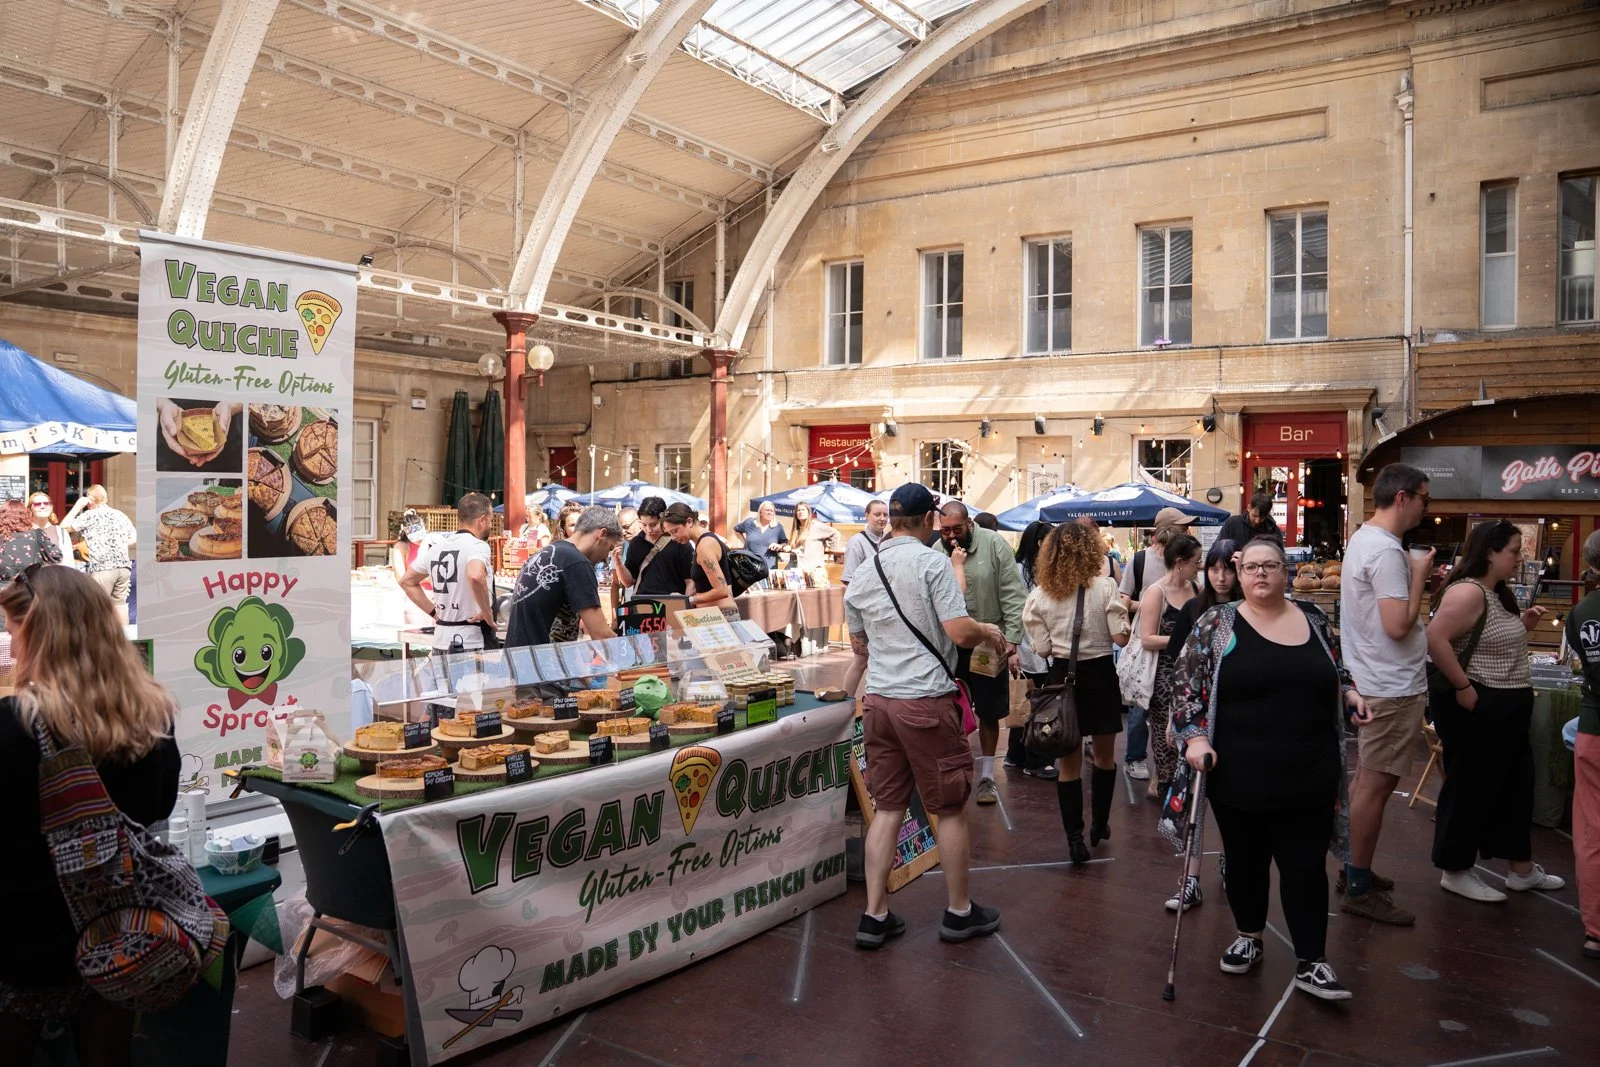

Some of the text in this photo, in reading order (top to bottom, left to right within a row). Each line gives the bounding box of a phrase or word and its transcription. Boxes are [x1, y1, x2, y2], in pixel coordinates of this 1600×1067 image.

[164, 259, 288, 312] VEGAN
[167, 309, 299, 359] QUICHE
[164, 359, 335, 397] Gluten-Free Options
[1280, 426, 1314, 441] Bar
[1501, 455, 1564, 494] Bath
[202, 570, 299, 599] Happy
[619, 620, 626, 636] 1
[627, 625, 640, 636] slice
[640, 617, 667, 635] £5.50
[213, 746, 263, 769] MADE
[715, 739, 852, 819] QUICHE
[456, 790, 665, 895] VEGAN
[579, 824, 784, 924] Gluten-Free Options
[539, 938, 619, 994] MADE
[628, 922, 659, 961] BY
[667, 898, 725, 943] YOUR
[733, 868, 805, 917] FRENCH
